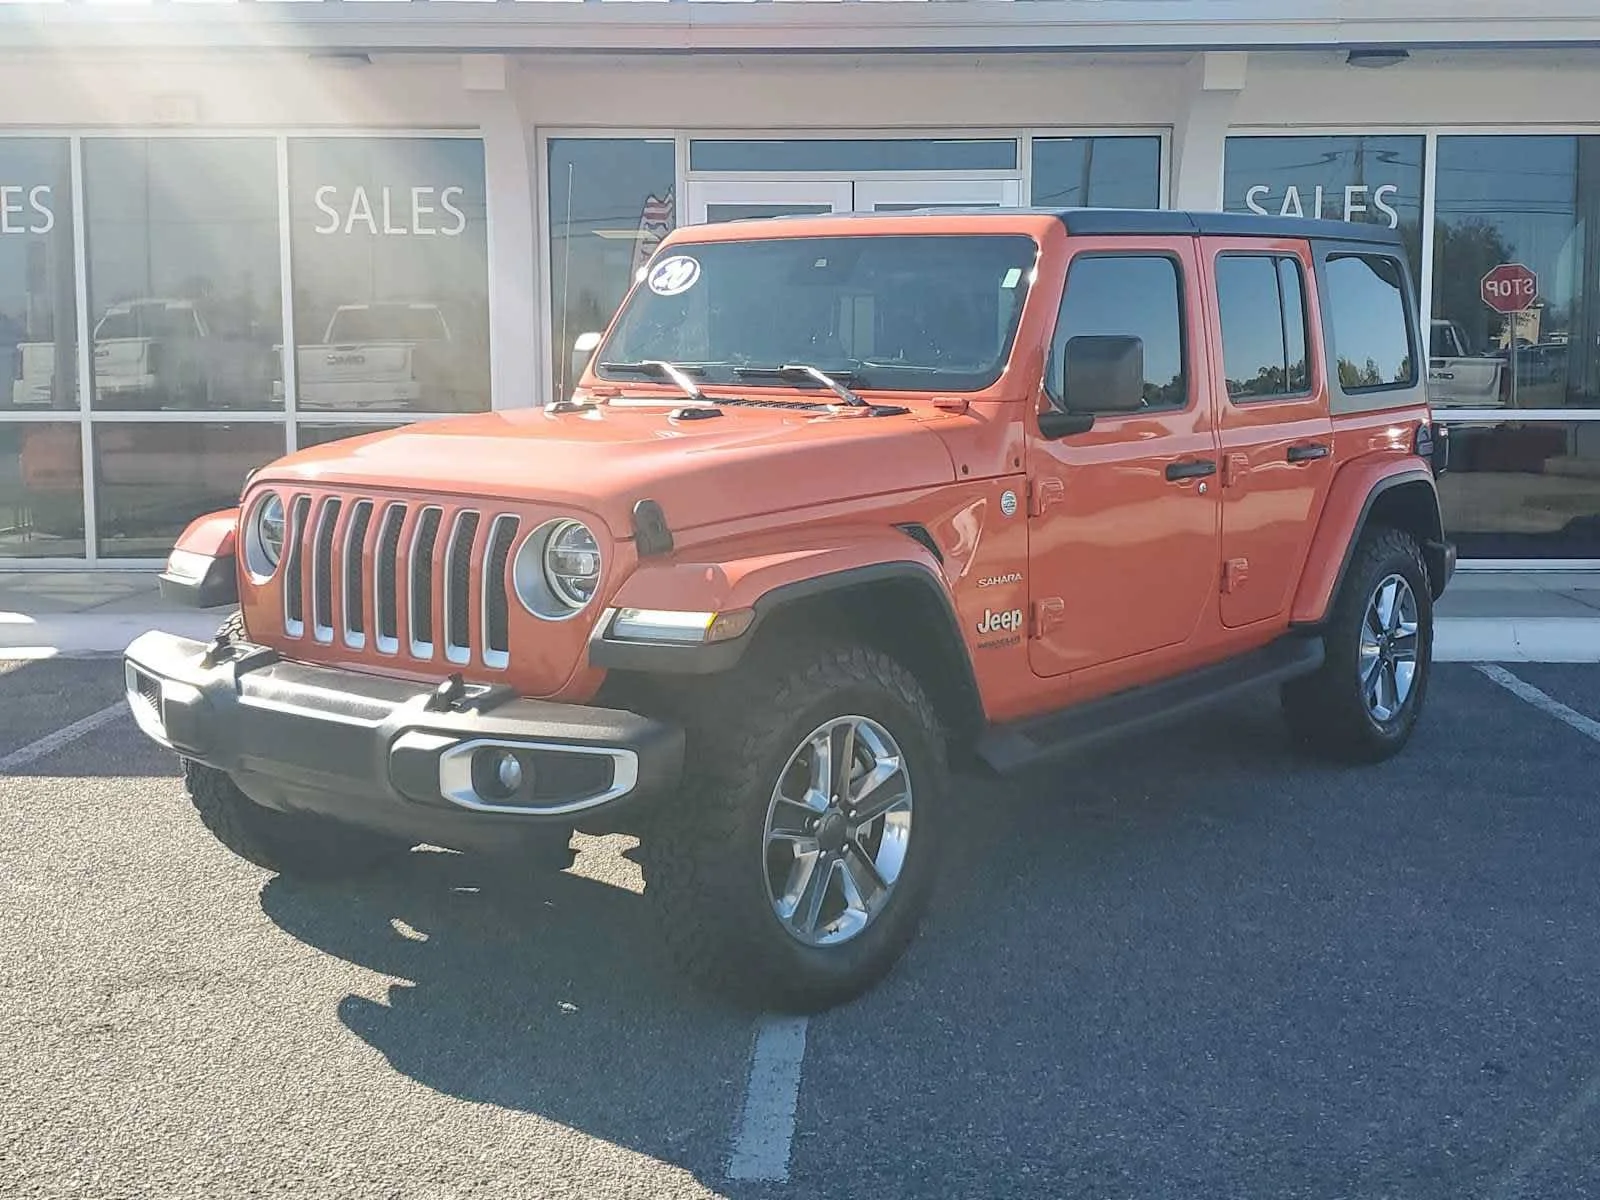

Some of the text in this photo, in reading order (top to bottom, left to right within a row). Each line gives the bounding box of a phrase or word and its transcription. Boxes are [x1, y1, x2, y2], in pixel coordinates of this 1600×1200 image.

[314, 185, 466, 236] SALES
[978, 573, 1023, 588] SAHARA
[977, 608, 1022, 634] Jeep
